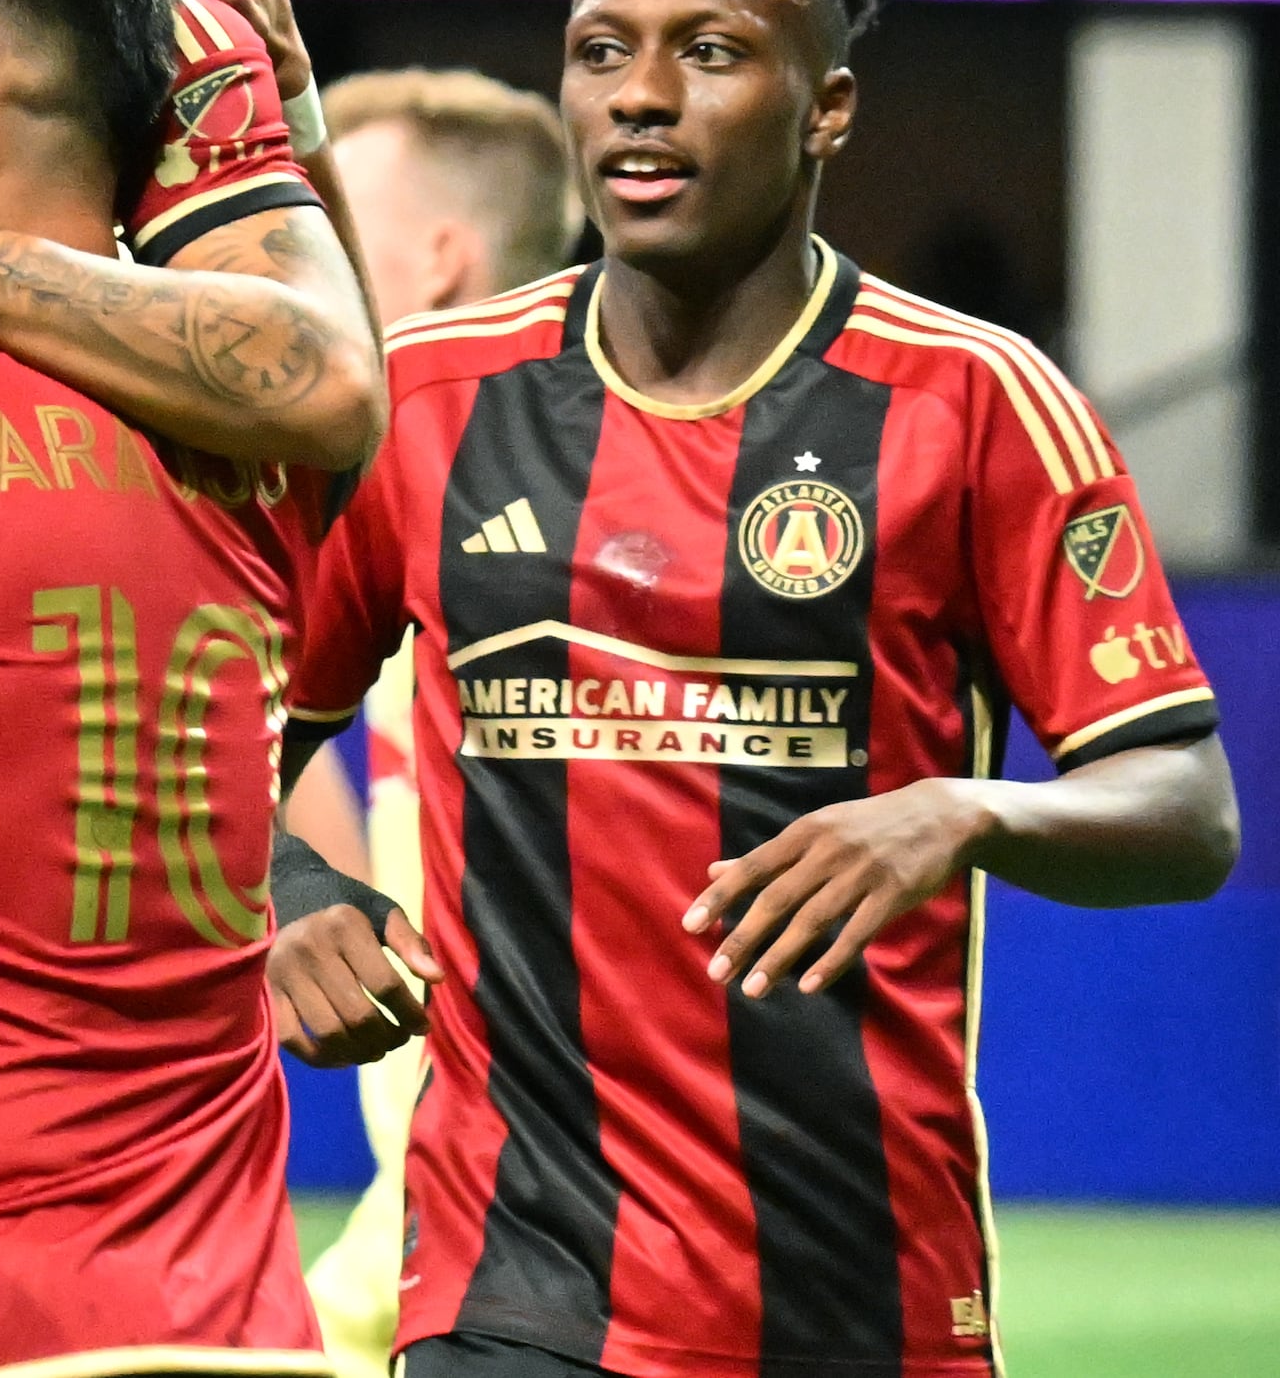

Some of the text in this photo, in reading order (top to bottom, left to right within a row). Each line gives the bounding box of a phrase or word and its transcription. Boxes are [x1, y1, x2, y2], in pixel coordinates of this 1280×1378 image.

[760, 485, 846, 515] ATLANTA
[752, 560, 819, 593] UNITED
[460, 677, 848, 725] AMERICAN FAMILY
[480, 726, 814, 759] INSURANCE
[31, 584, 292, 949] 10
